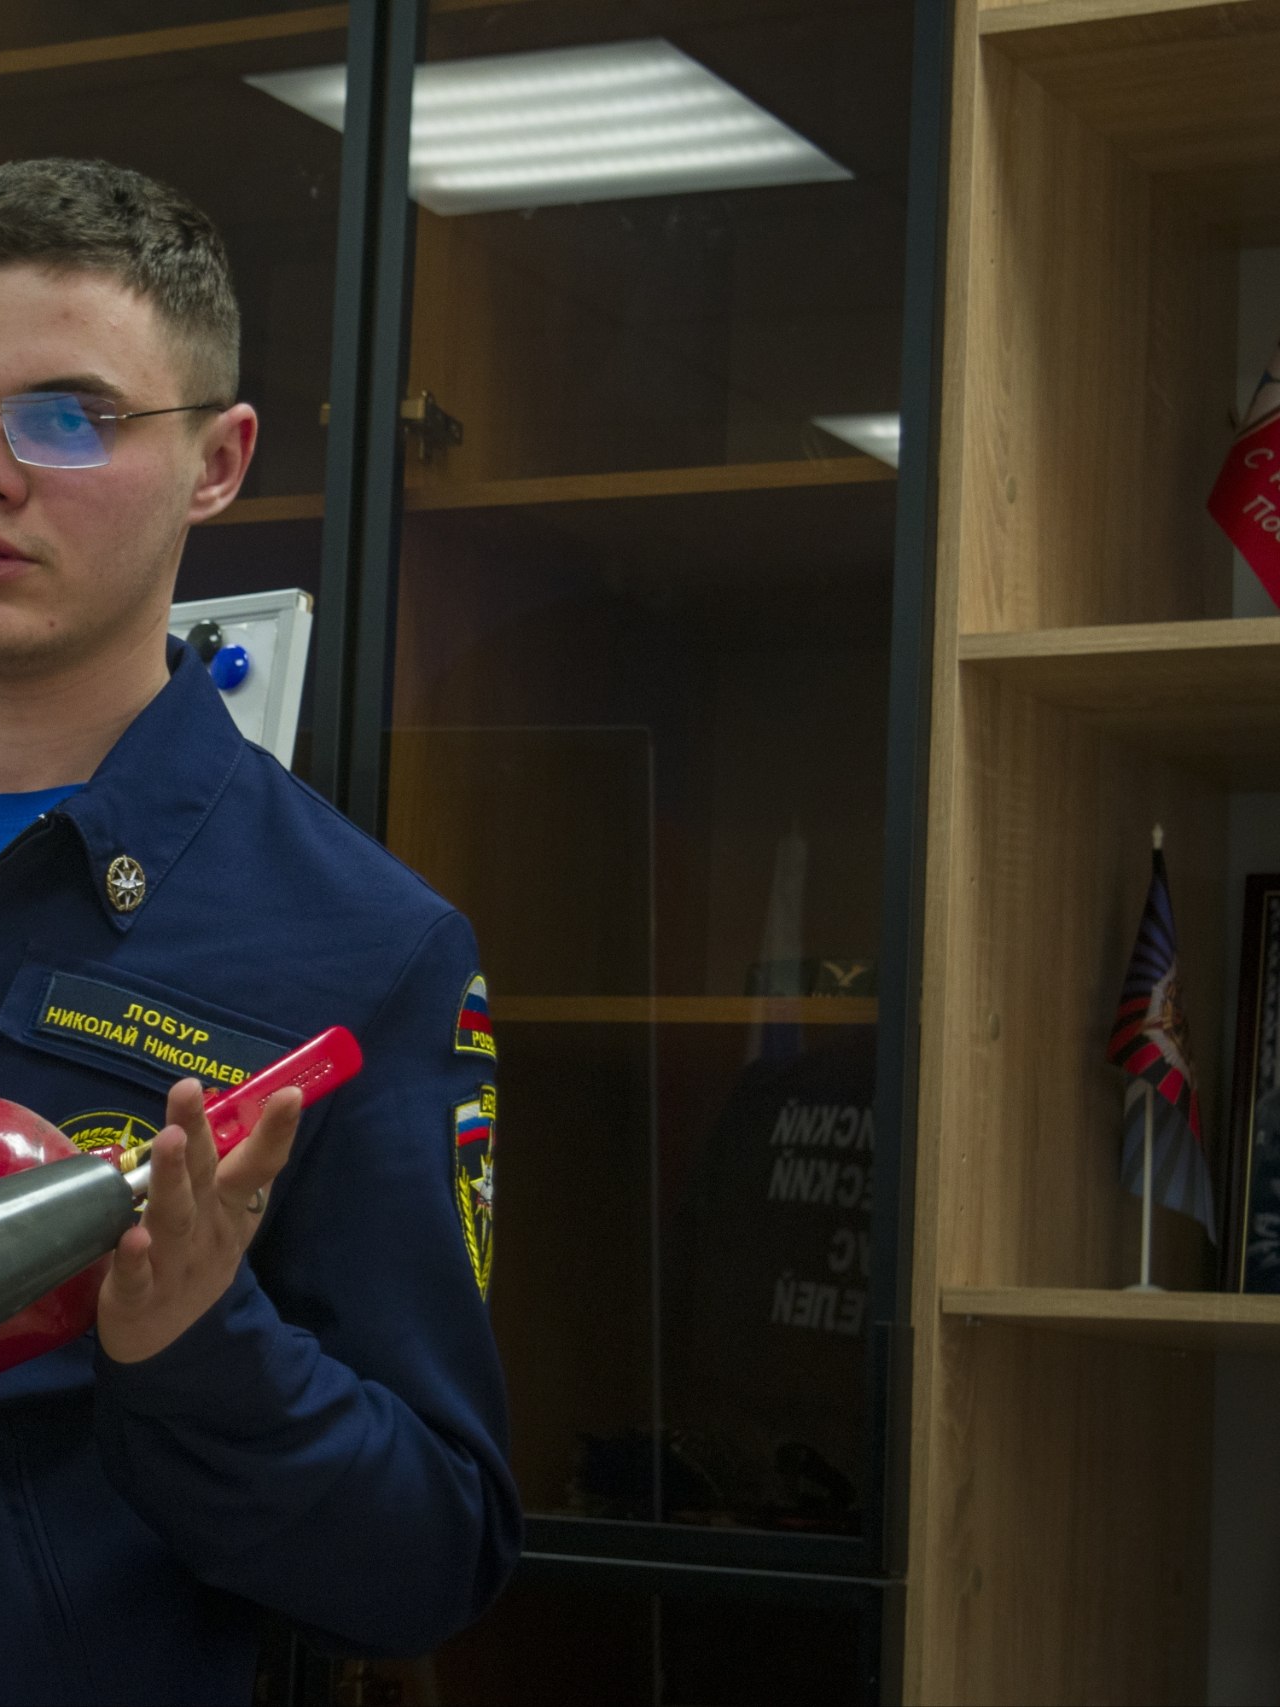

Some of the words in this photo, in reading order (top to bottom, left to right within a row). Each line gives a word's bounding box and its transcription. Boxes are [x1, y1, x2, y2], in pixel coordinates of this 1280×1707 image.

[1242, 494, 1280, 543] По
[45, 1006, 139, 1047] НИКОЛАЙ
[143, 1035, 251, 1086] НИКОЛАЕВ
[123, 1003, 209, 1046] ЛОБУР
